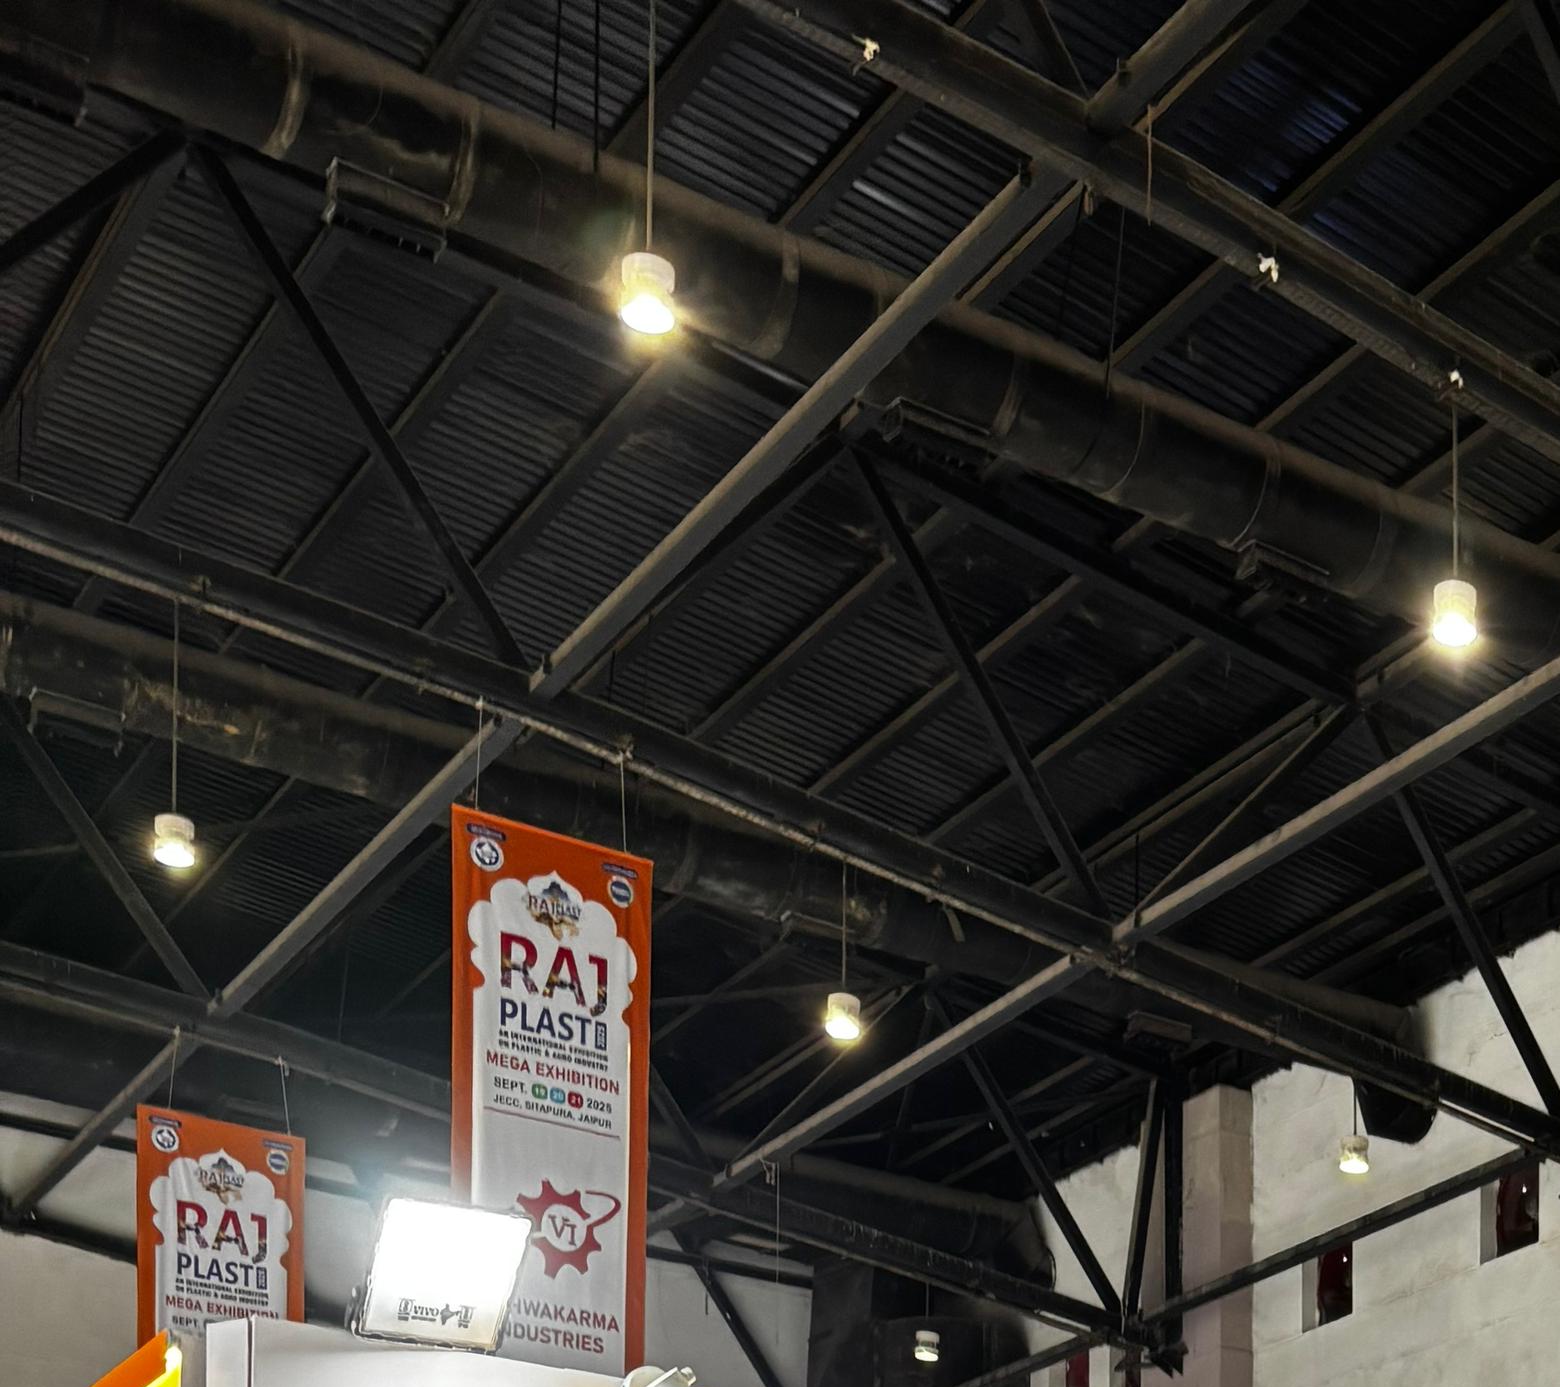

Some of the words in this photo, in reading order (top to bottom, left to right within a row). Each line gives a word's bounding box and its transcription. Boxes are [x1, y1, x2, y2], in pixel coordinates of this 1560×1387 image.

[500, 932, 608, 1017] RAJ
[500, 997, 592, 1045] PLAST
[486, 1049, 531, 1074] MEGA
[535, 1061, 619, 1095] EXHIBITION
[176, 1199, 267, 1264] RAJ
[177, 1252, 253, 1287] PLAST
[165, 1295, 203, 1312] MEGA
